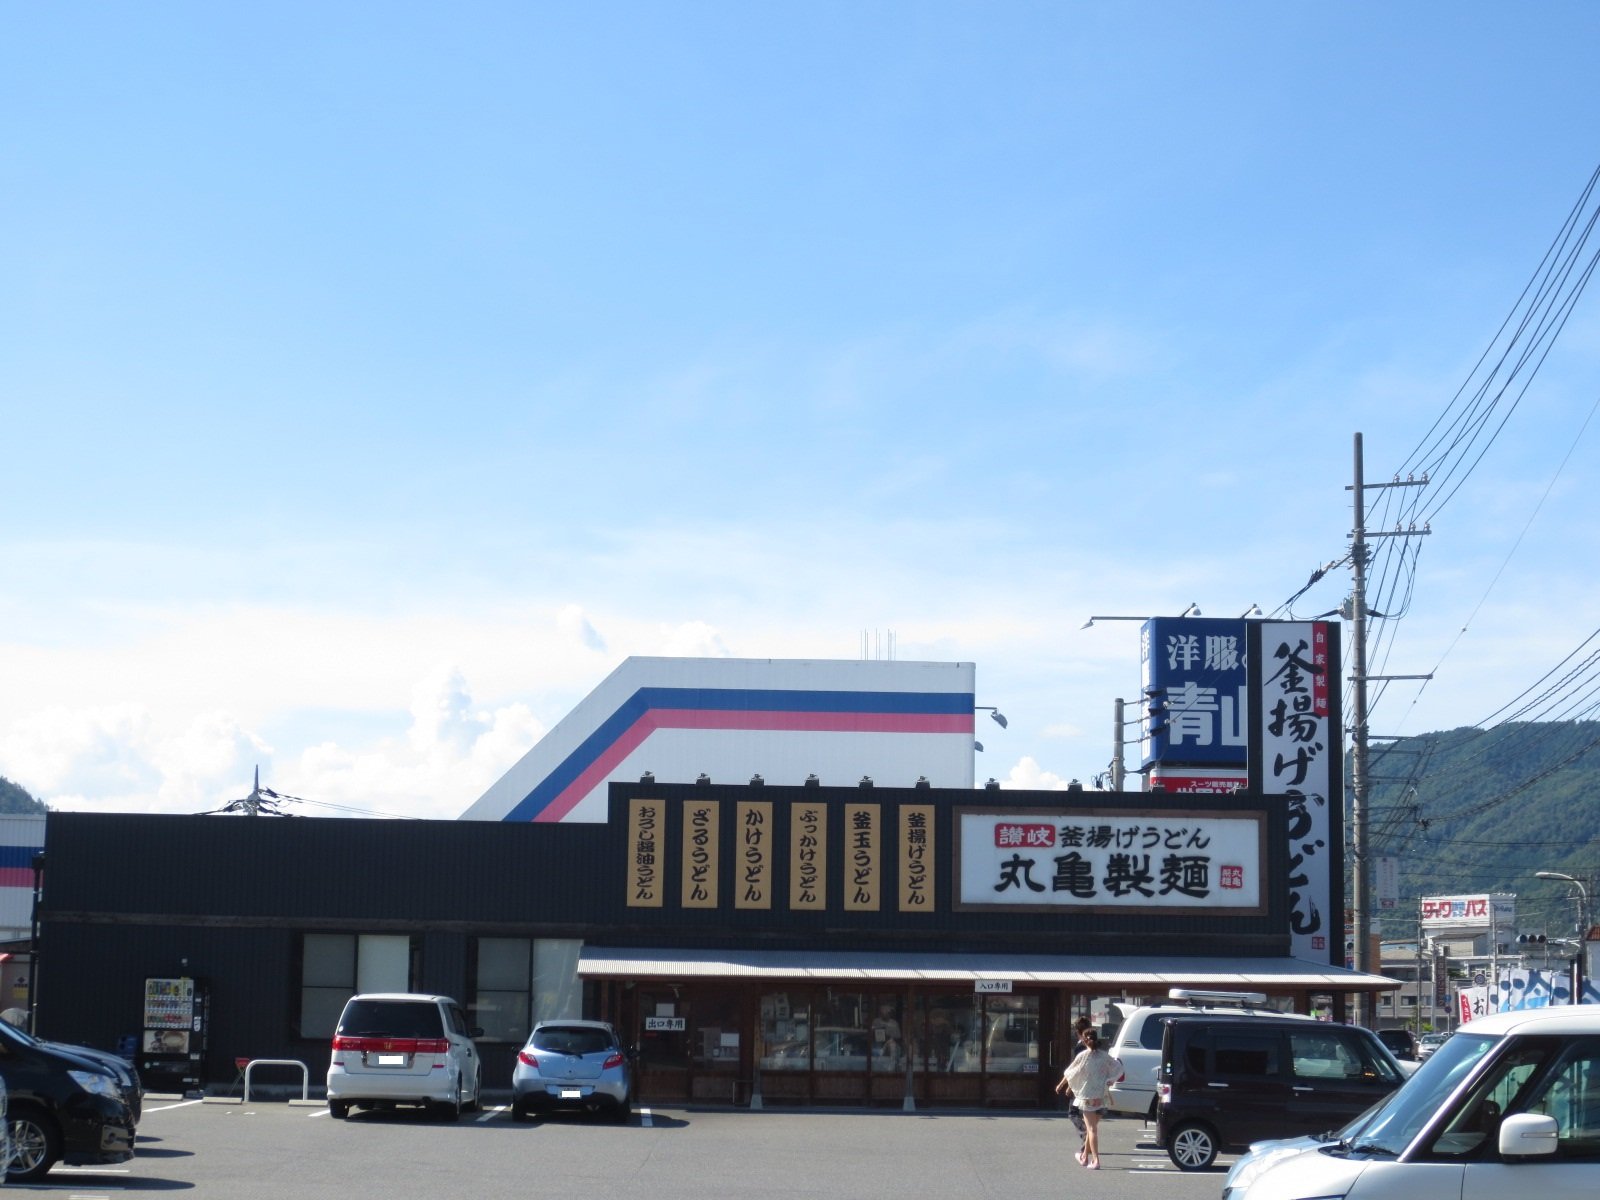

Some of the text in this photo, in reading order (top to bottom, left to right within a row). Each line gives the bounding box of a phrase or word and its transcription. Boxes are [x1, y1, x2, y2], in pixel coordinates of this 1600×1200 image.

[1166, 634, 1247, 671] 洋服
[690, 808, 711, 901] ざるうどん
[744, 809, 763, 902] かけうどん
[799, 810, 818, 903] ぶっかけうどん
[852, 811, 871, 904] 釜玉うどん
[907, 812, 927, 905] 釜揚げうどん
[1058, 826, 1211, 850] 釜揚げうどん
[994, 851, 1211, 898] 丸亀製麺
[979, 982, 1009, 991] 入口専用
[648, 1019, 683, 1029] 出口専用
